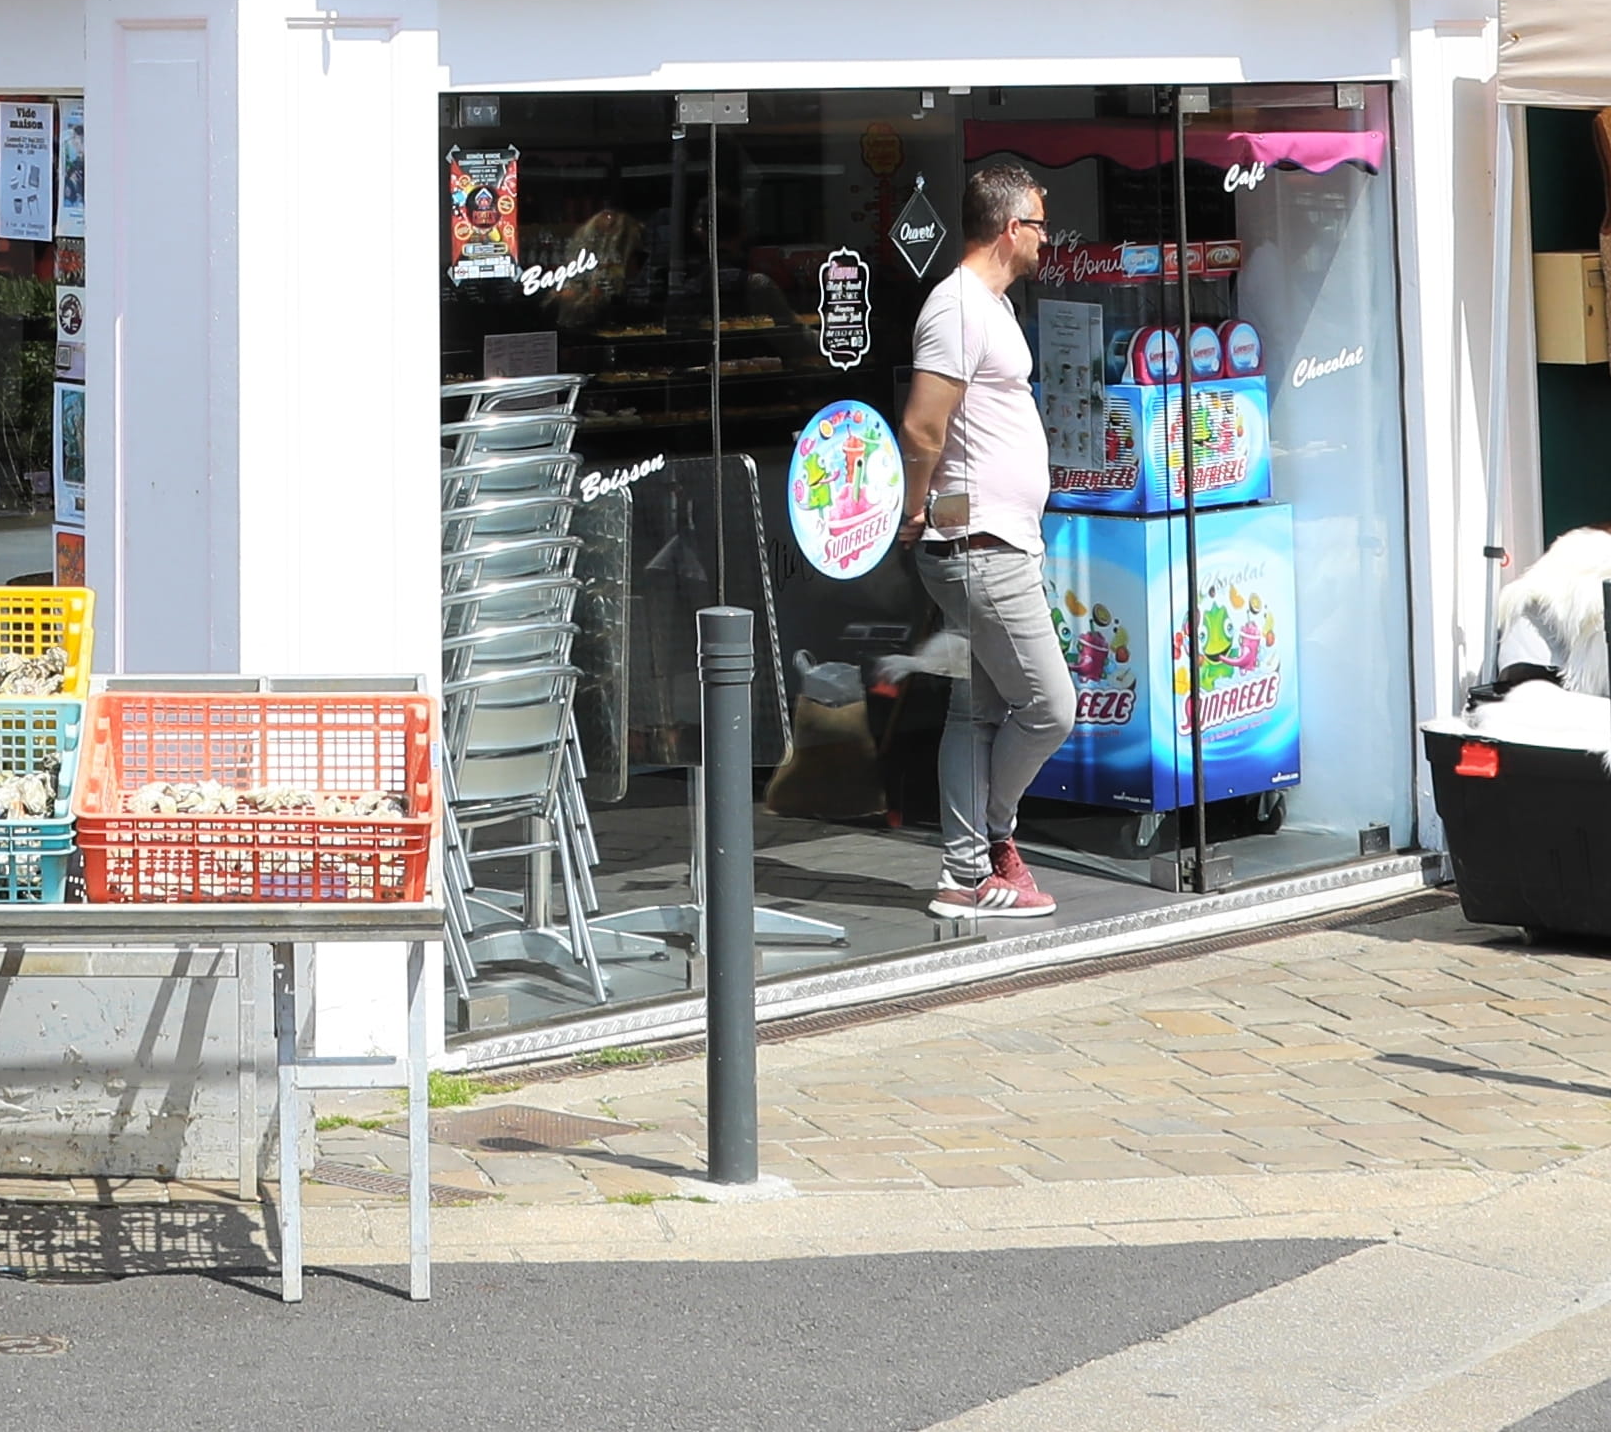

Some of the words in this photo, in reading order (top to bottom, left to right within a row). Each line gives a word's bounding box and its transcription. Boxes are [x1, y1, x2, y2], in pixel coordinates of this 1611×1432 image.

[9, 119, 44, 130] maison
[16, 107, 37, 118] Vide
[1224, 161, 1265, 192] Café
[900, 222, 936, 241] Ouvert
[520, 248, 599, 296] Bagels
[1292, 345, 1365, 388] Chocolat
[580, 452, 666, 503] Boisson
[823, 513, 889, 565] SUNFREEZE
